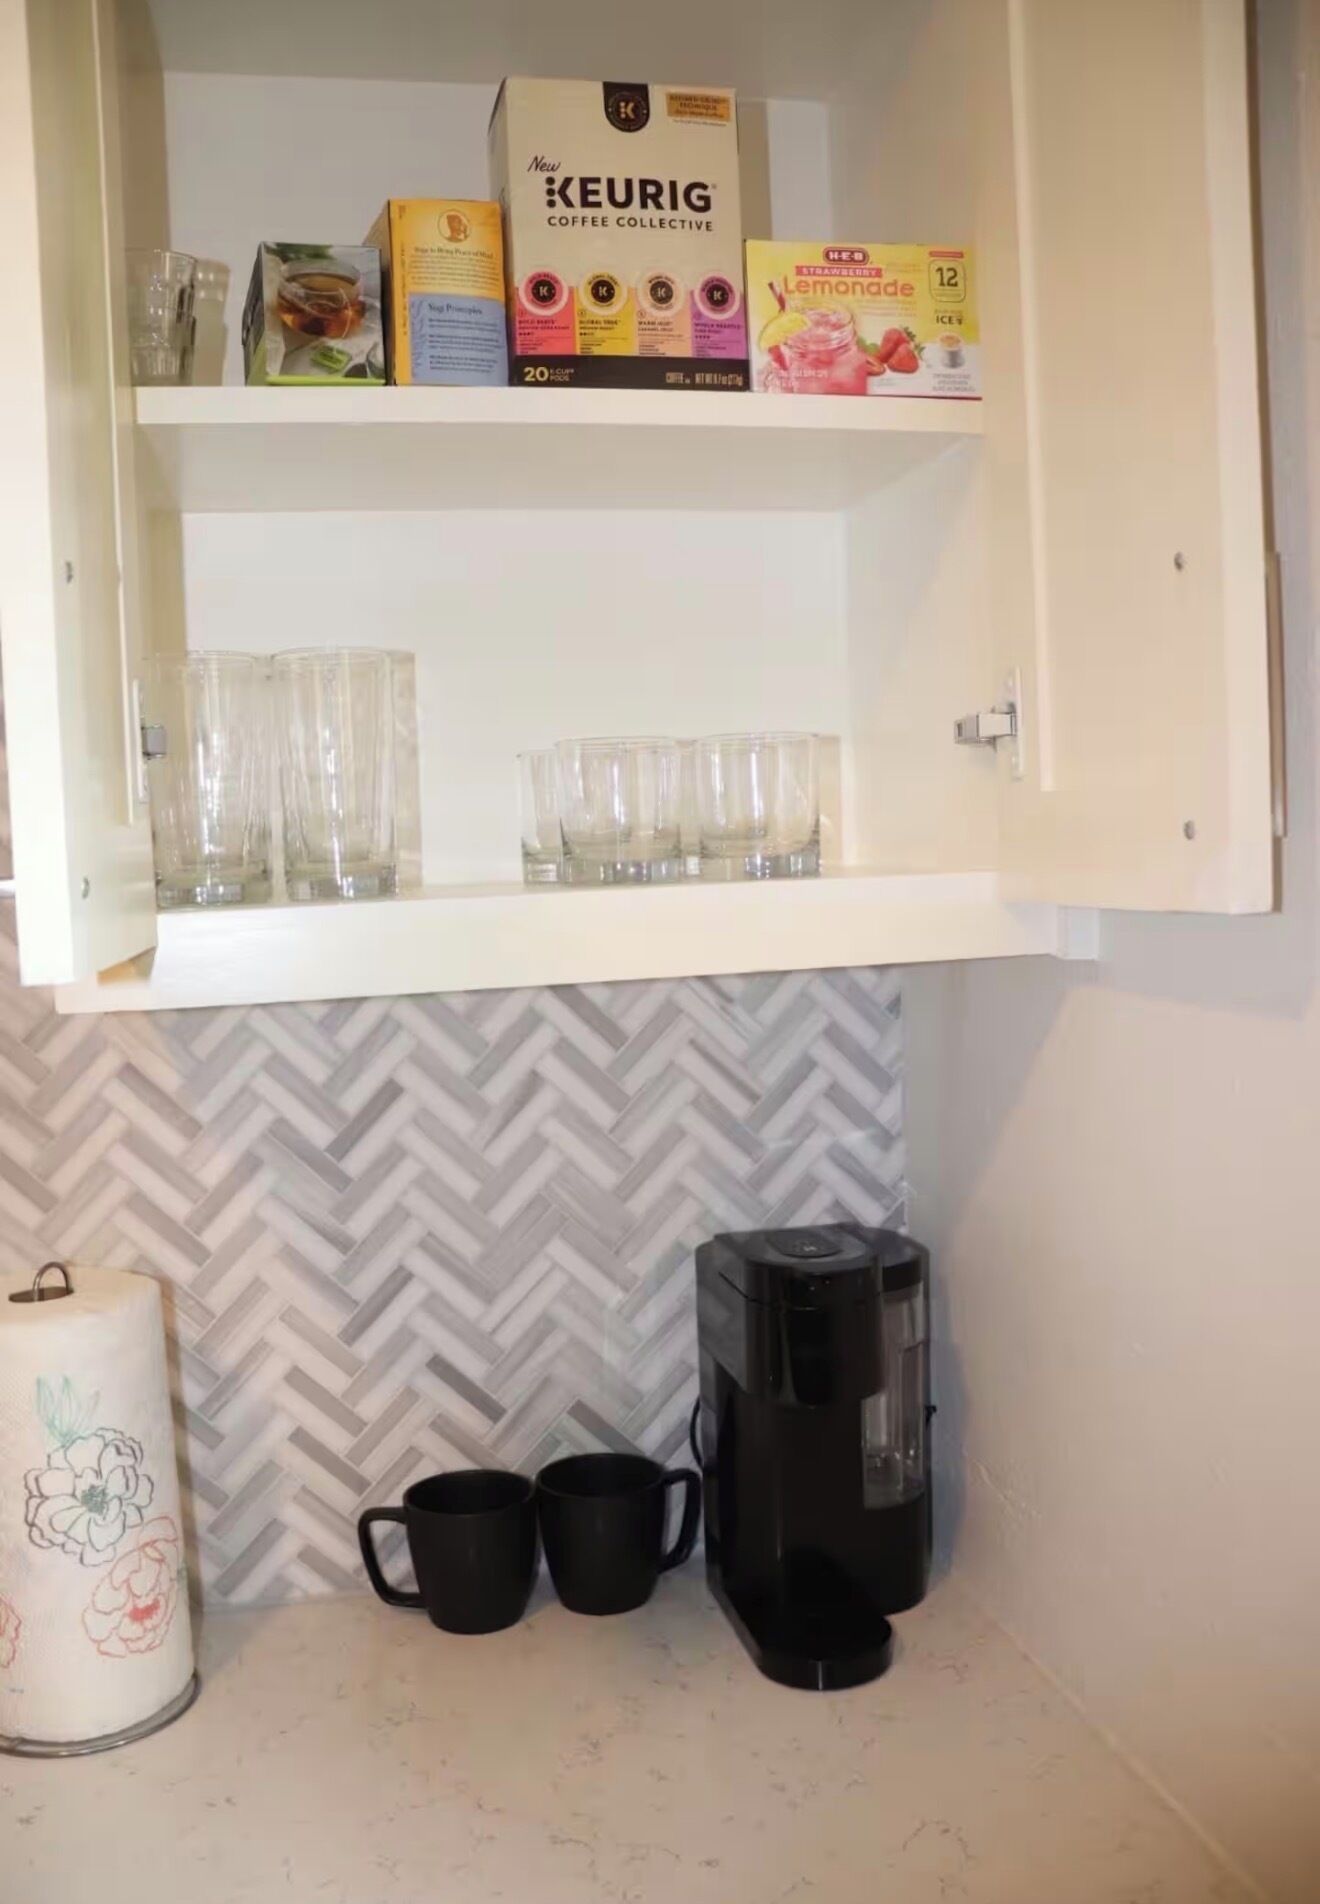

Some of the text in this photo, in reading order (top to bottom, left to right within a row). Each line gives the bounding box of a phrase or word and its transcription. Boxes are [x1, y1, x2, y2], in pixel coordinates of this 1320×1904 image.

[527, 155, 562, 173] New
[545, 176, 712, 214] KEURIG
[547, 216, 713, 232] COFFEE COLLECTIVE
[828, 251, 864, 261] H-E-B
[802, 267, 877, 277] STRAWBERRY
[935, 266, 958, 287] 12
[783, 275, 915, 297] Lemonade
[523, 366, 549, 382] 20
